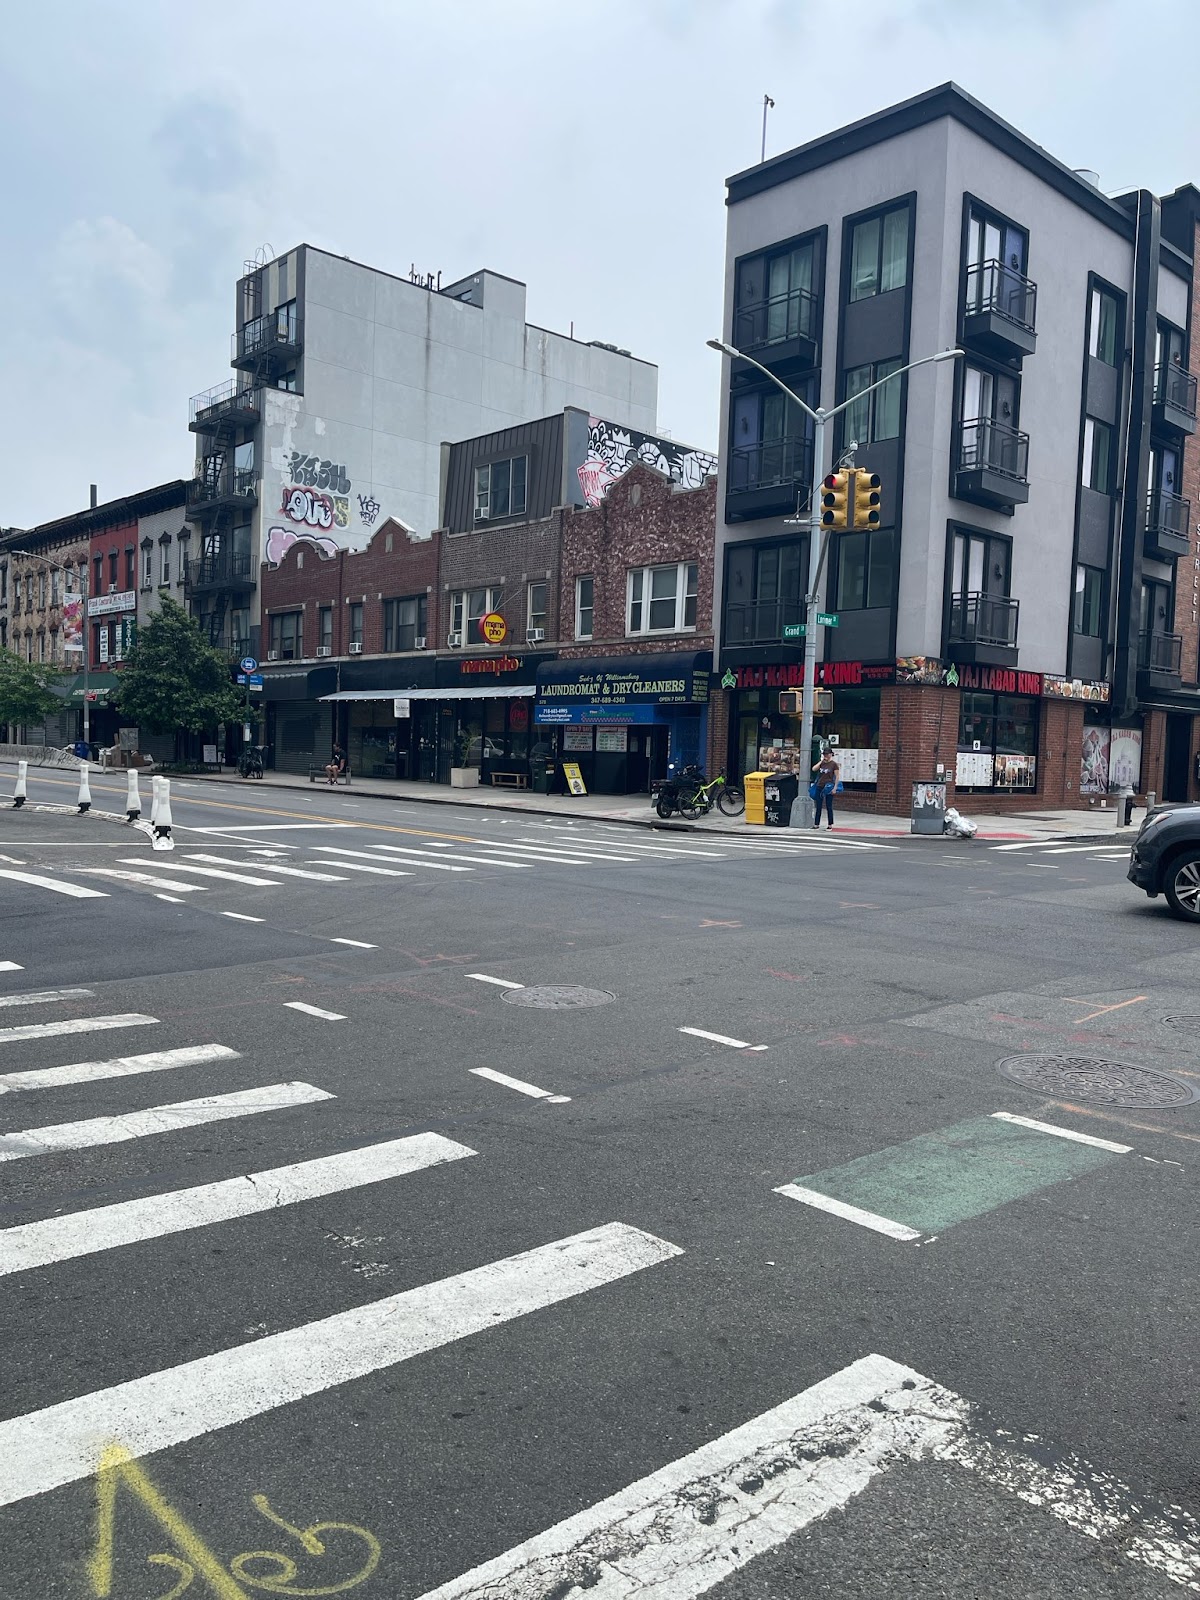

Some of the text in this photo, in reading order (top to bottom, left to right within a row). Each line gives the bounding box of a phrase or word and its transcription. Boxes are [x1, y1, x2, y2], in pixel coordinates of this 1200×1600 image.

[485, 621, 505, 629] mama
[488, 628, 502, 638] pho
[784, 626, 800, 636] Grand
[736, 666, 763, 688] TAJ
[823, 661, 862, 685] KING
[958, 664, 1040, 695] TAJ KABAB KING
[541, 682, 600, 697] LAUNDROMAT
[602, 682, 610, 695] &
[612, 681, 632, 695] DRY
[632, 679, 686, 694] CLEANERS
[590, 696, 626, 704] 347-689-4340
